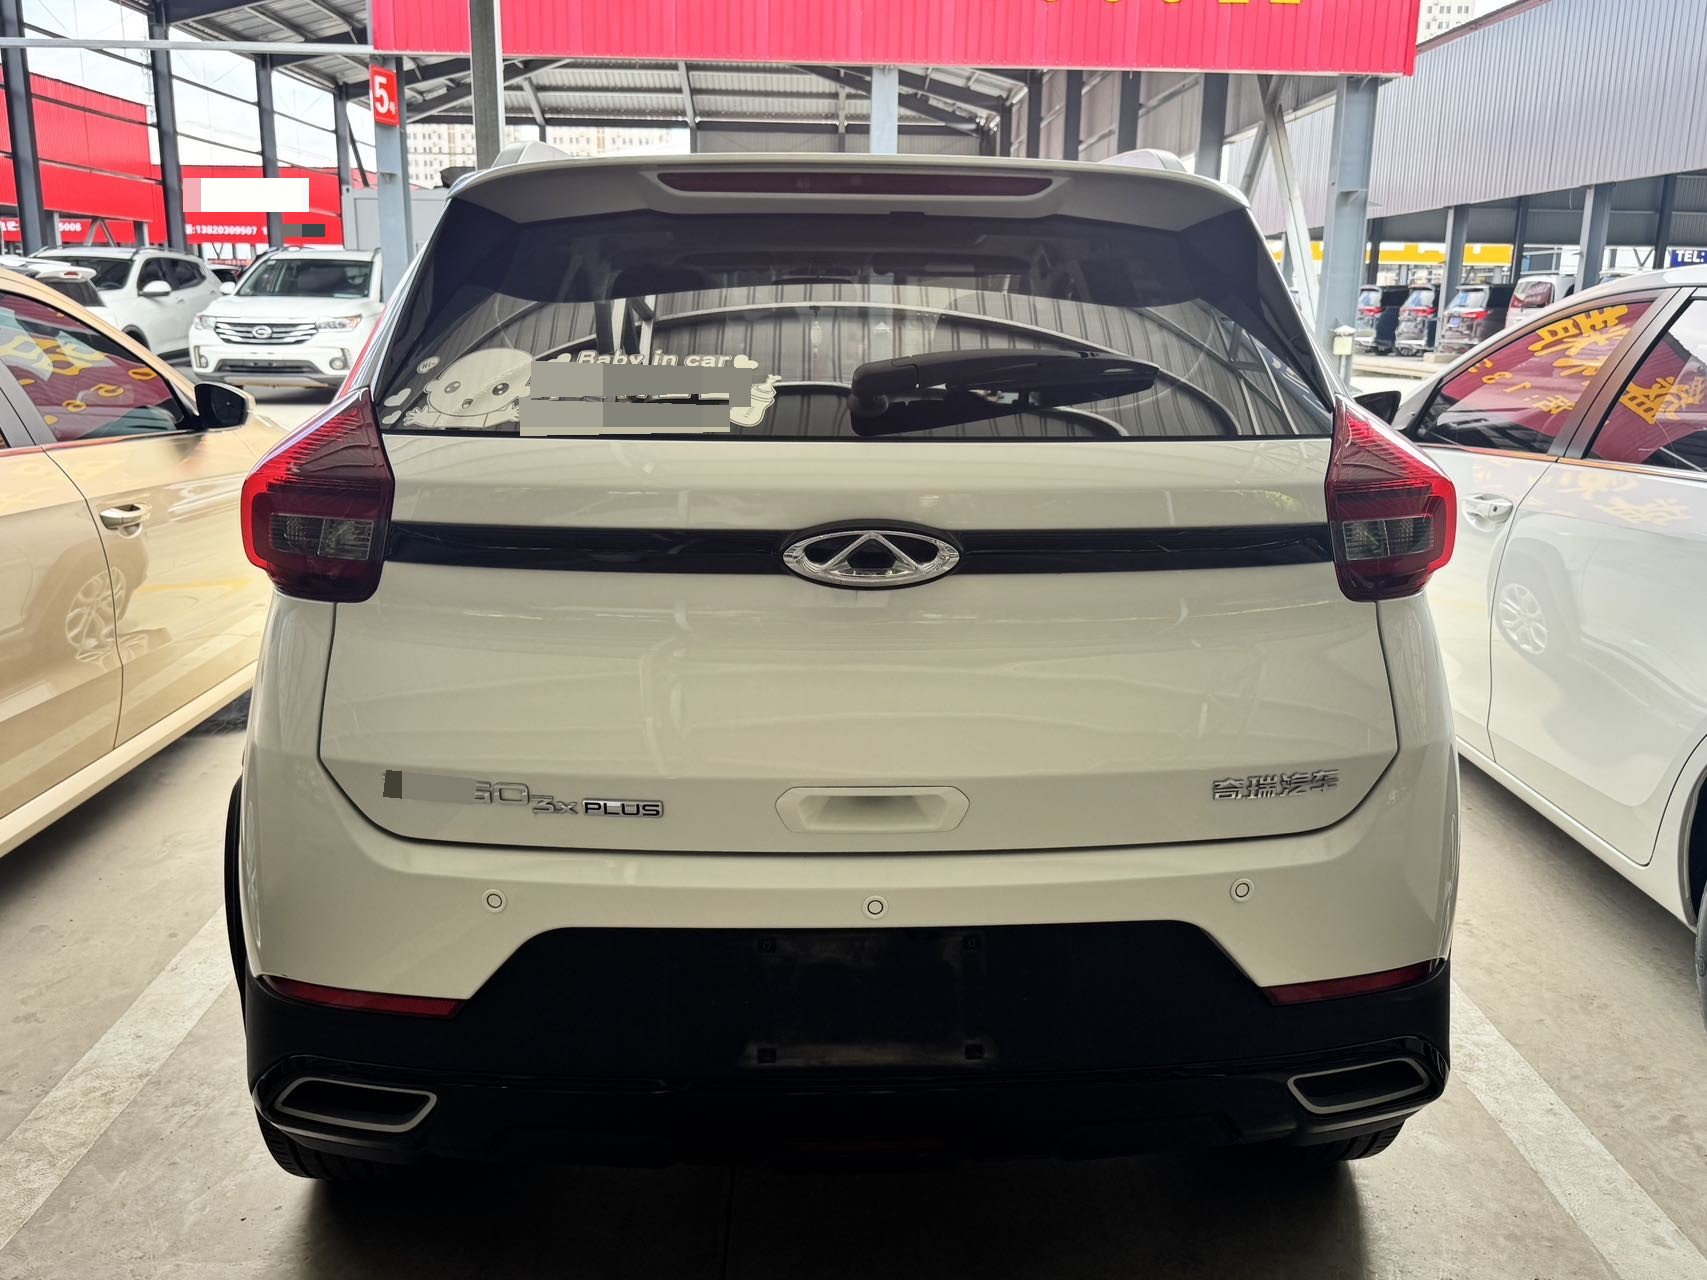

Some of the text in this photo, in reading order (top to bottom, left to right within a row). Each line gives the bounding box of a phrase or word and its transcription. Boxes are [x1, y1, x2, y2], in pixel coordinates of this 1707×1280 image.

[1676, 250, 1706, 263] TEL:
[652, 348, 679, 366] in
[684, 354, 732, 368] car
[1213, 769, 1340, 801] 奇瑞汽车
[584, 800, 662, 817] PLUS
